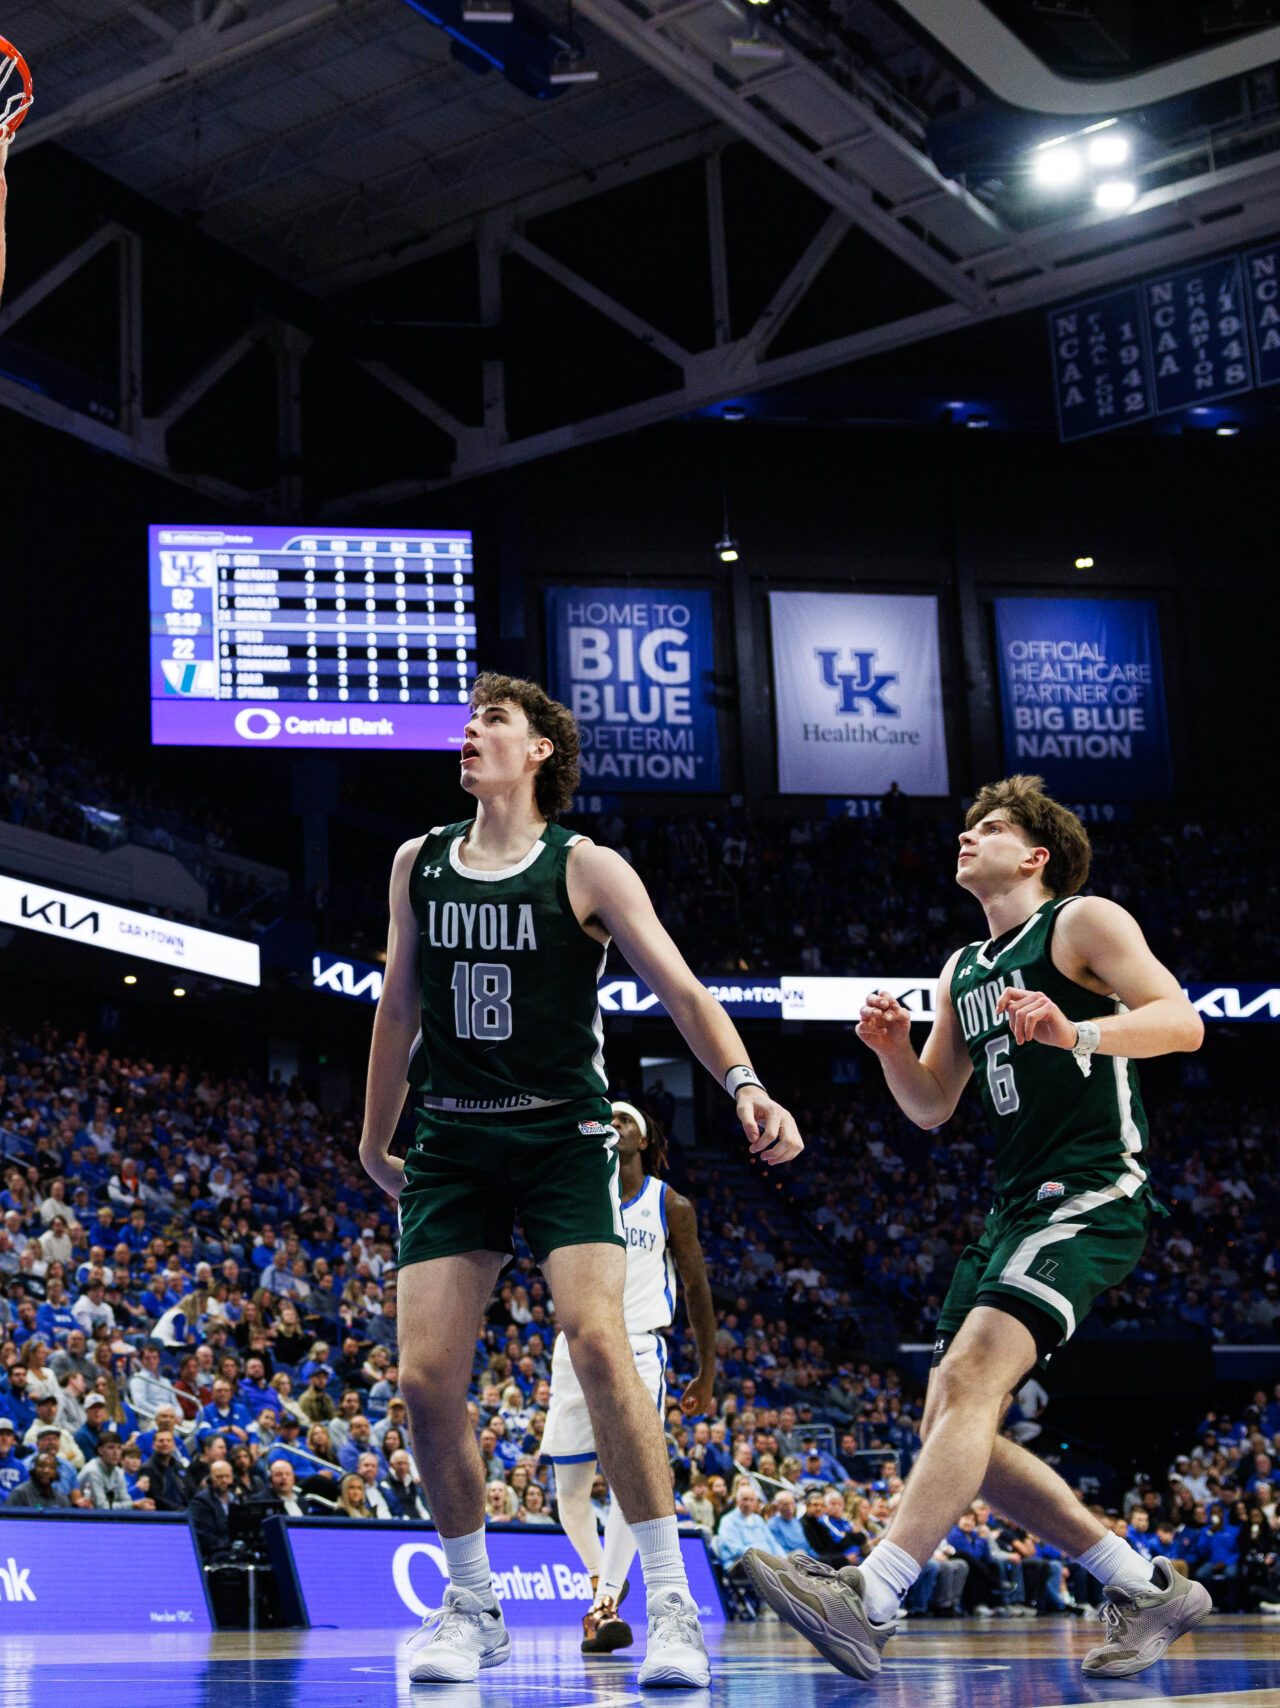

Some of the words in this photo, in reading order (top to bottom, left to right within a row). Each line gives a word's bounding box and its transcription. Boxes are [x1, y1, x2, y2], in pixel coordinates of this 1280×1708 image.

[1150, 282, 1181, 378] NCAA
[1055, 313, 1086, 408] NCAA
[567, 602, 649, 627] HOME
[653, 603, 691, 628] TO
[172, 638, 195, 660] 22
[568, 626, 691, 685] BIG
[1009, 640, 1107, 662] OFFICIAL
[815, 648, 900, 718] UK
[1011, 660, 1152, 685] HEALTHCARE
[571, 683, 693, 725] BLUE
[1013, 682, 1108, 705] PARTNER
[1109, 683, 1145, 705] OF
[285, 716, 347, 734] Central
[349, 718, 394, 736] Bank
[803, 722, 921, 746] HealthCare
[1015, 705, 1067, 731] BIG
[1071, 706, 1147, 732] BLUE
[1017, 734, 1132, 759] NATION
[21, 894, 99, 934] KIA
[428, 900, 538, 950] LOYOLA
[451, 960, 513, 1040] 18
[984, 1033, 1020, 1116] 6
[490, 1563, 556, 1601] entral
